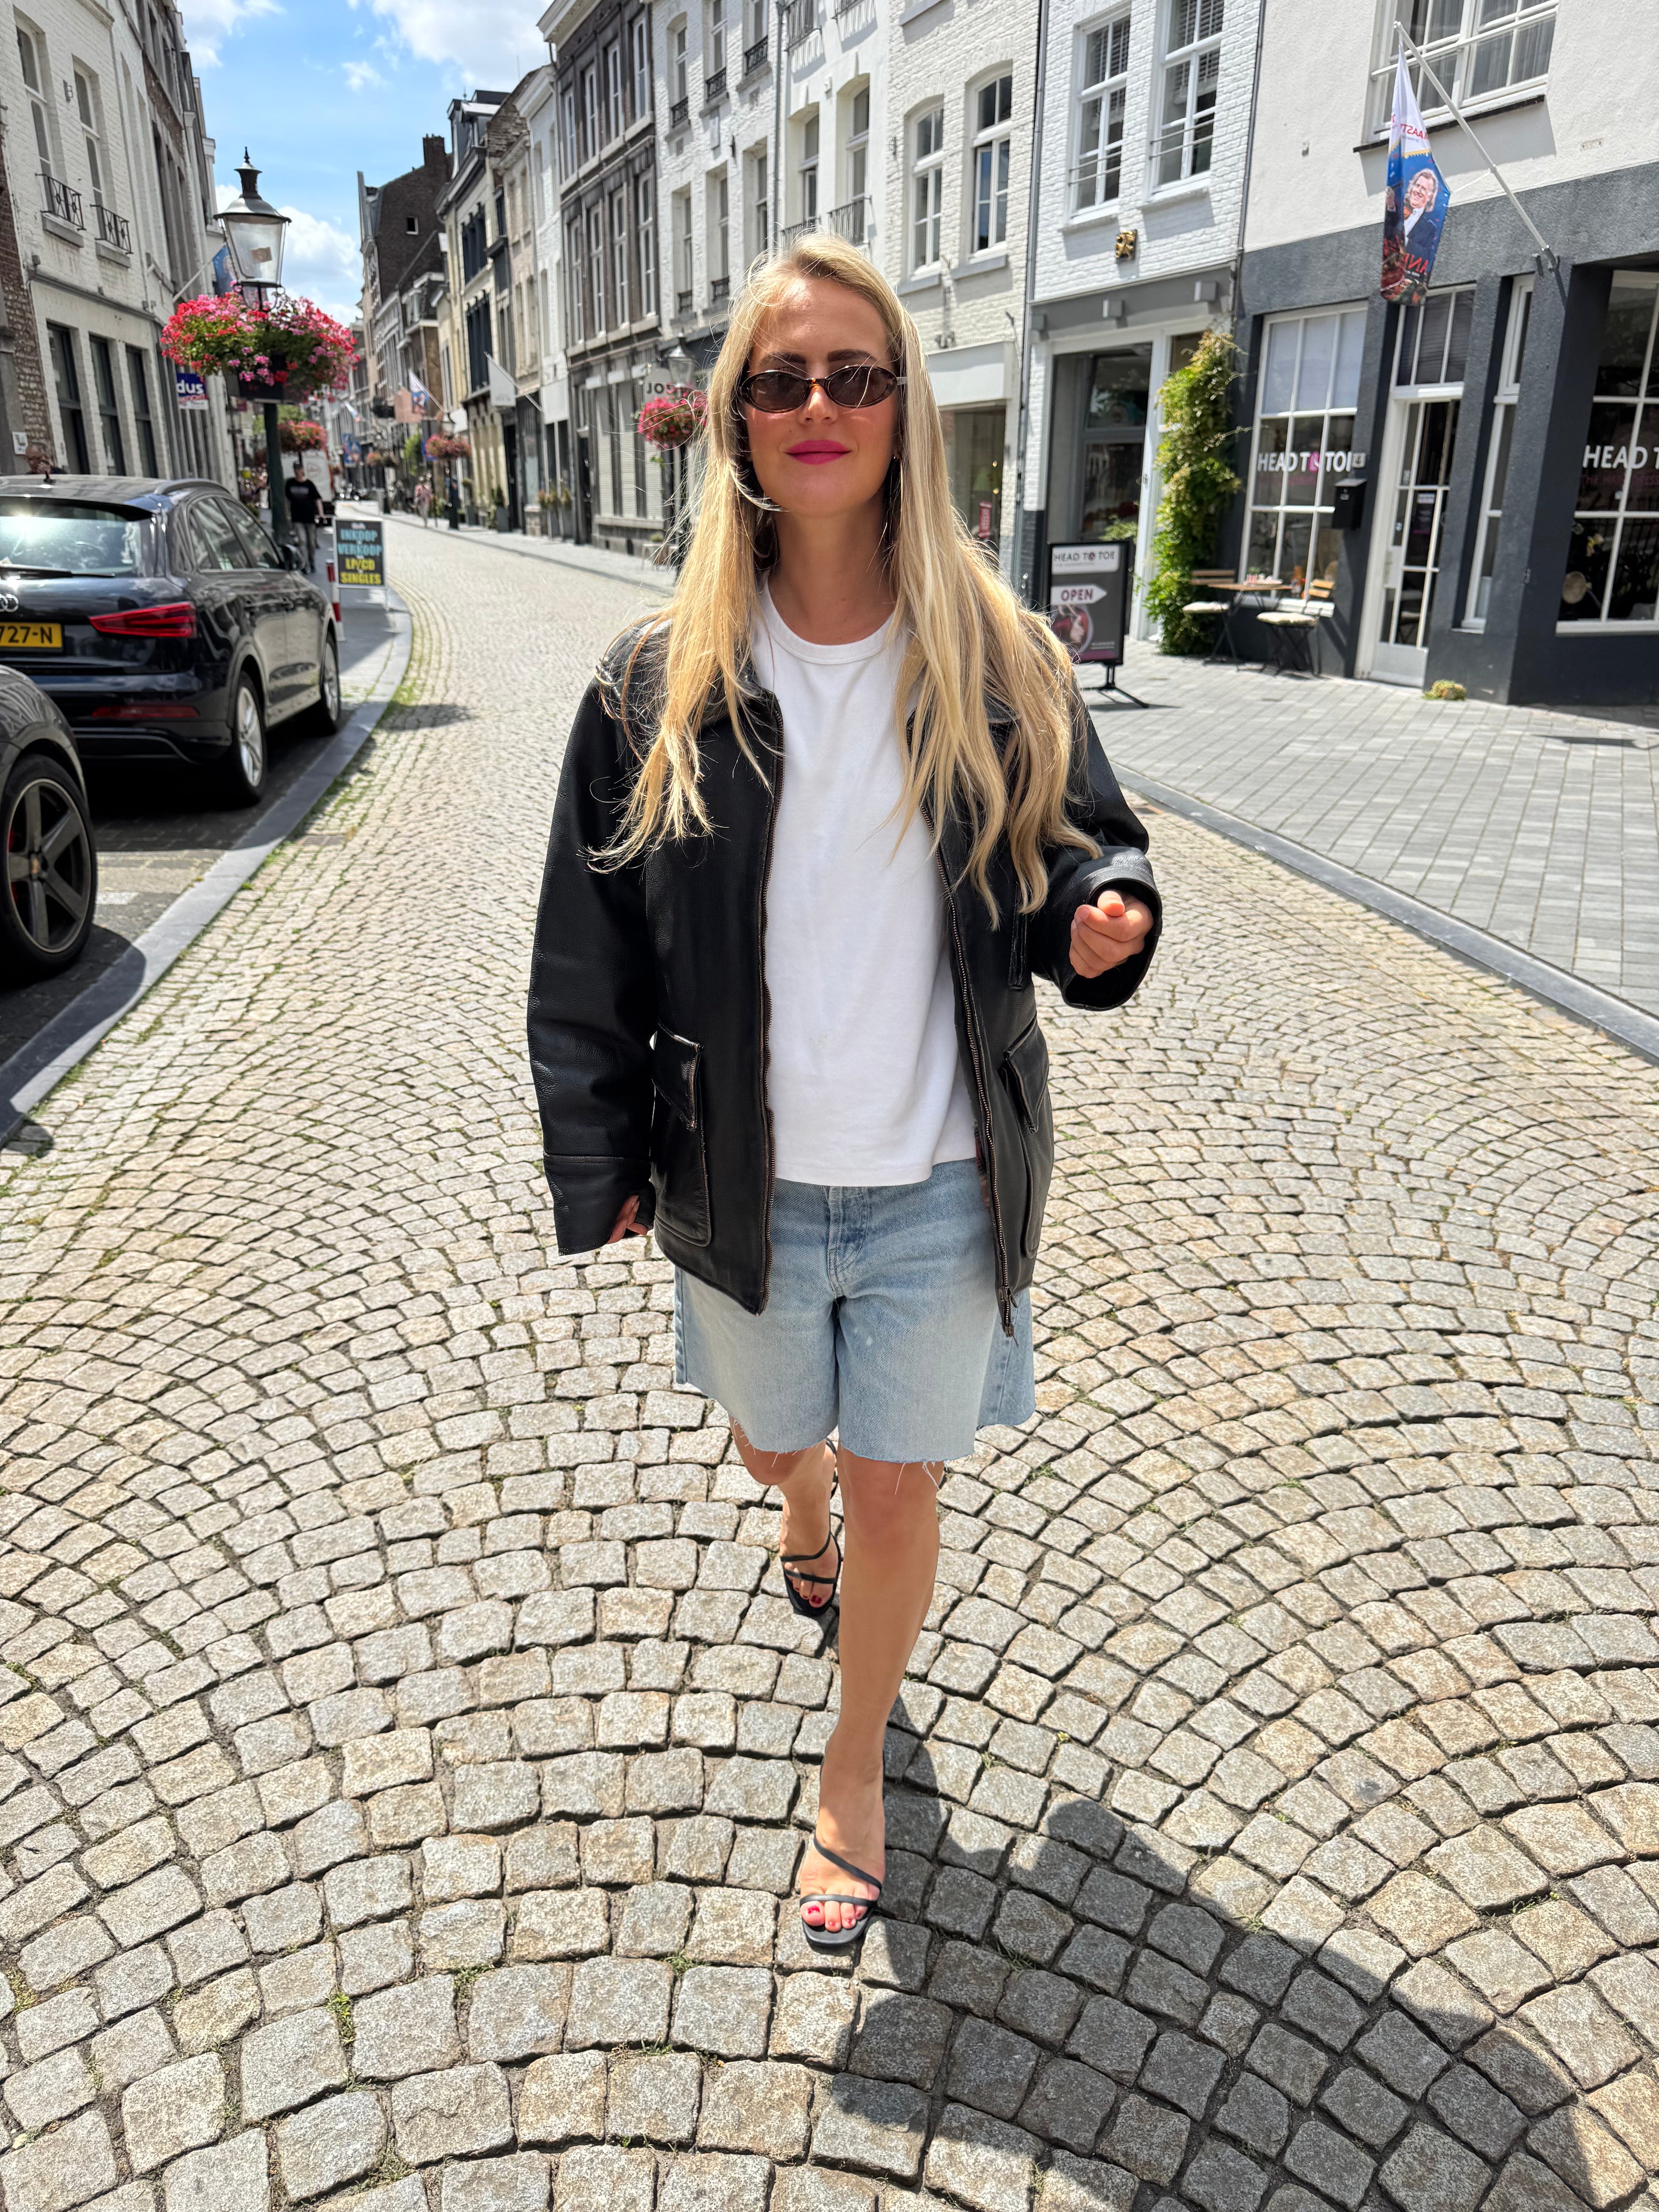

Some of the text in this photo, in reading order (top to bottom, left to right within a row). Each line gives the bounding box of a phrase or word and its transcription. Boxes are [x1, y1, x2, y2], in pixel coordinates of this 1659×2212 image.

[1257, 452, 1298, 472] HEAD
[1582, 445, 1648, 469] HEAD
[340, 529, 377, 542] INKOOP
[338, 543, 382, 556] VERKOOP
[1053, 552, 1080, 562] HEAD
[1098, 551, 1116, 560] TOE
[345, 558, 375, 571] LP/CD
[340, 572, 382, 584] SINGLES
[1061, 589, 1094, 601] OPEN
